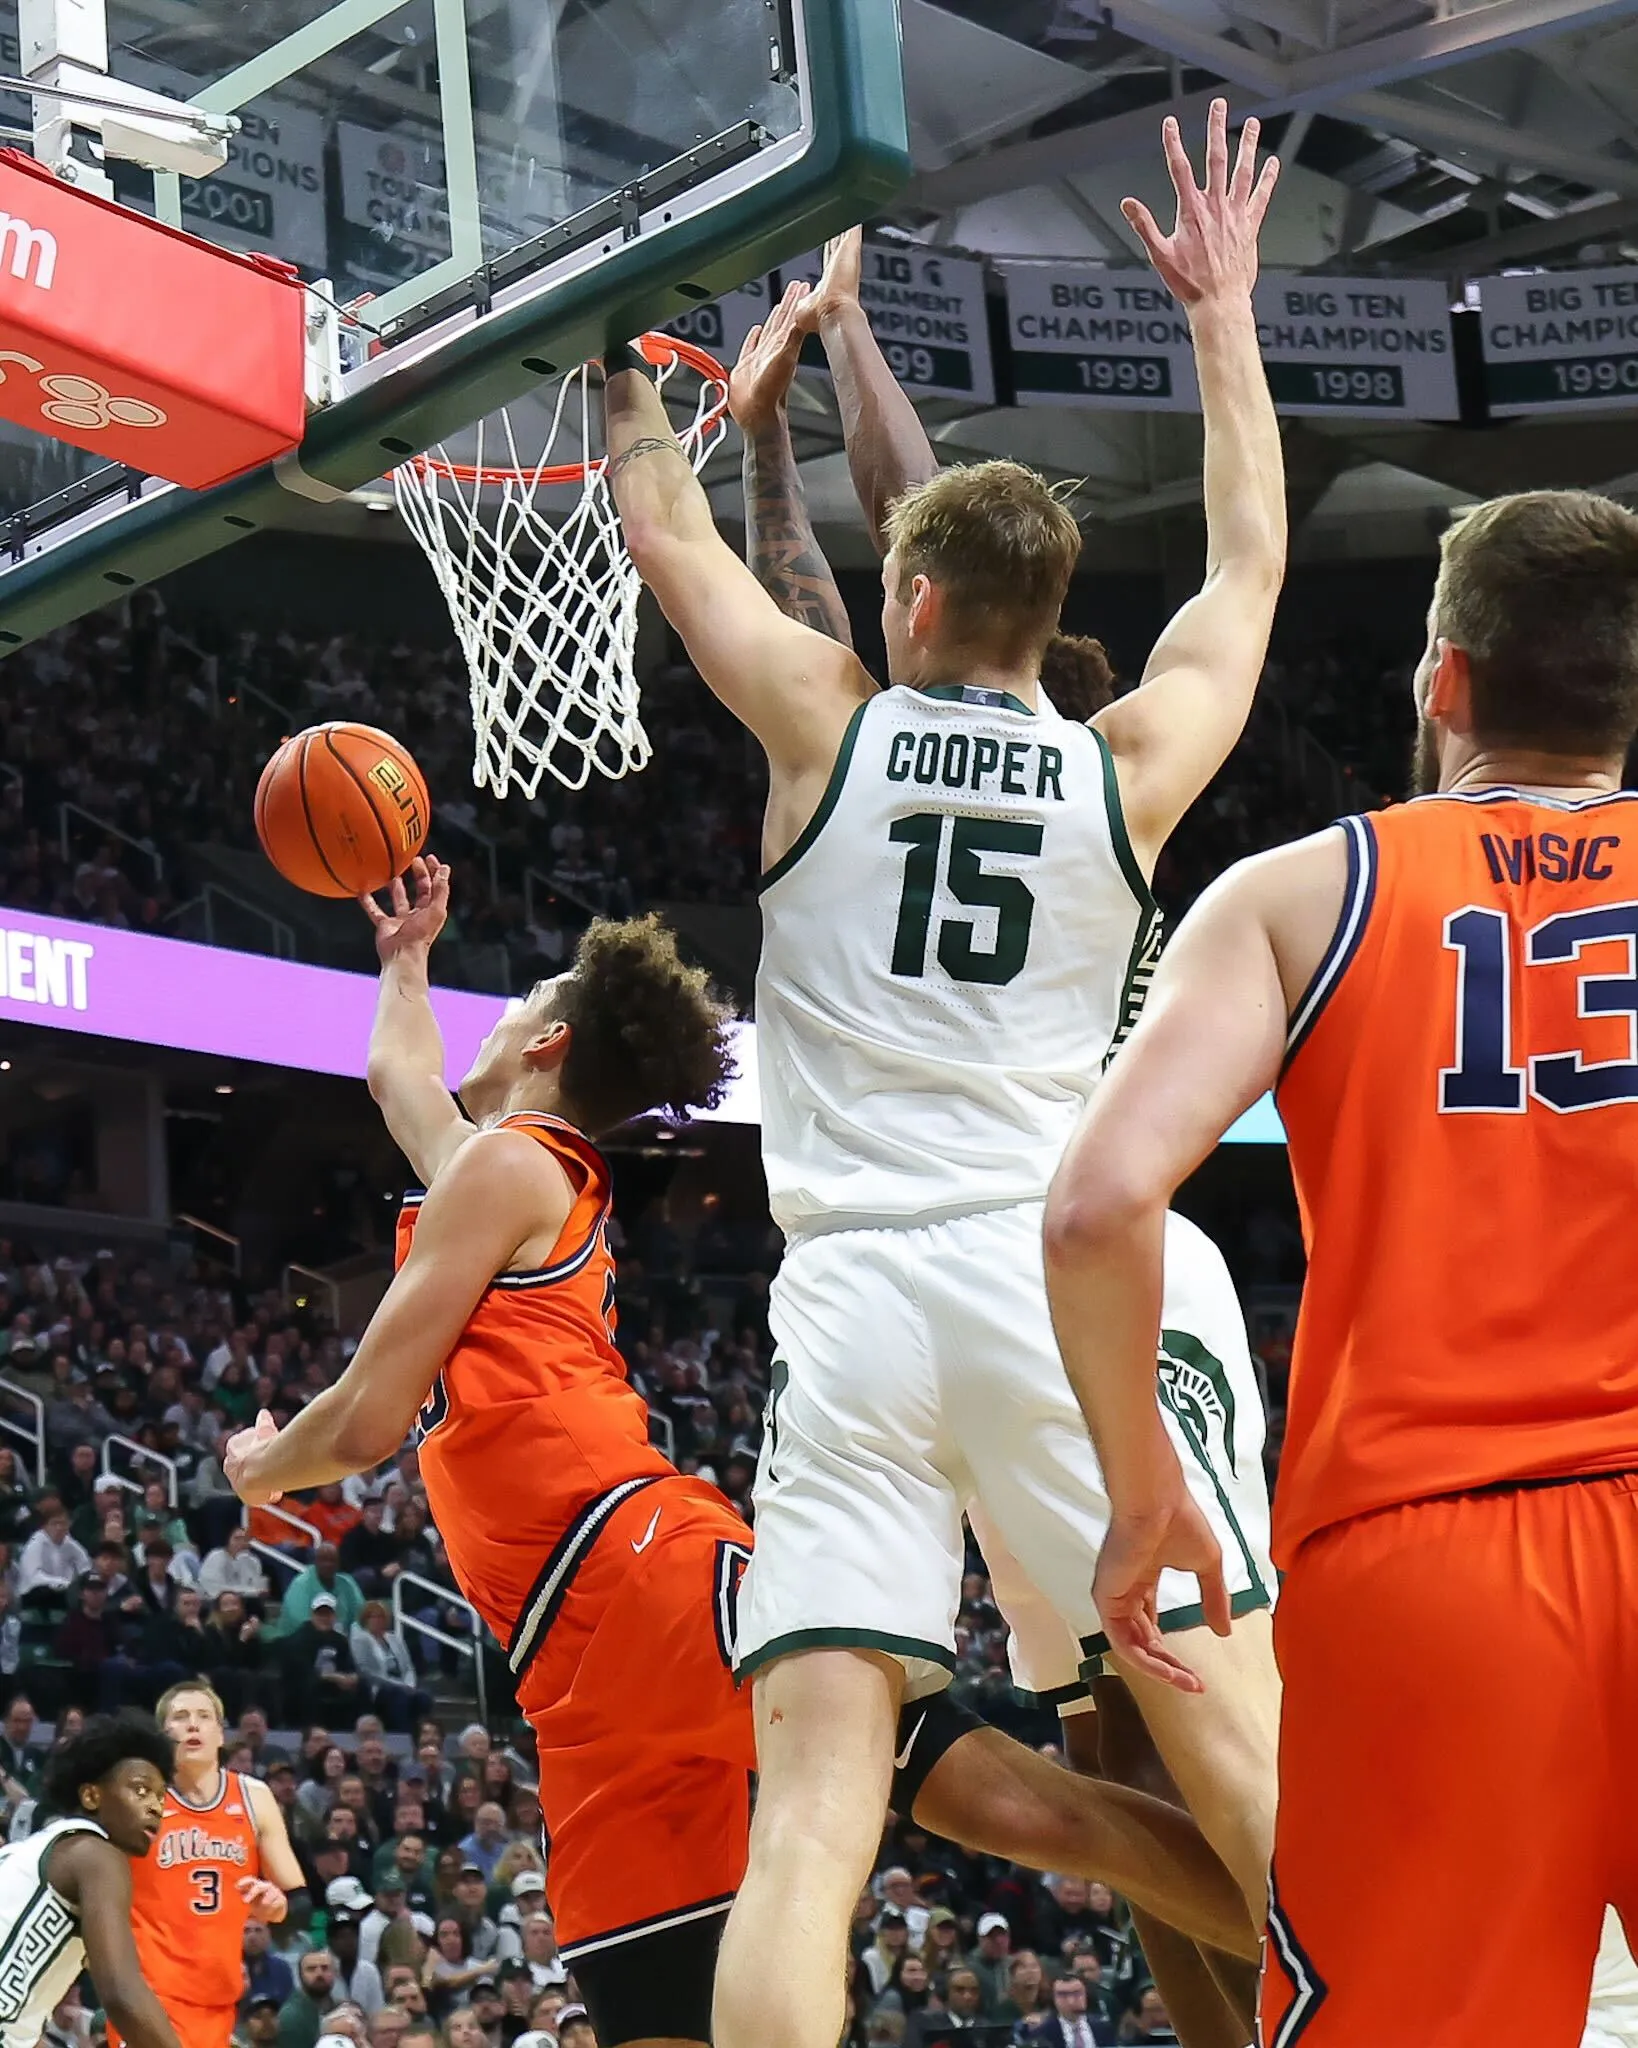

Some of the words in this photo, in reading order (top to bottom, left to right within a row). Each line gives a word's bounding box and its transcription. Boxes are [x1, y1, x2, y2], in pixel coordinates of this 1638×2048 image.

[240, 112, 281, 145] EN
[228, 143, 320, 193] PIONS
[182, 180, 267, 229] 2001
[1052, 284, 1104, 309] BIG
[1113, 287, 1174, 312] TEN
[1284, 291, 1339, 317] BIG
[1346, 293, 1406, 319] TEN
[1526, 286, 1583, 314] BIG
[672, 307, 718, 339] 00
[868, 309, 969, 344] MPIONS
[1016, 315, 1193, 345] CHAMPION
[1257, 324, 1448, 354] CHAMPIONS
[887, 346, 935, 383] 99
[1077, 360, 1162, 392] 1999
[1312, 371, 1396, 401] 1998
[885, 731, 1066, 801] COOPER
[373, 758, 422, 847] ELITE
[887, 812, 1045, 987] 15
[0, 928, 94, 1011] ENT
[1436, 899, 1638, 1115] 13
[158, 1828, 246, 1868] Illinois
[190, 1869, 221, 1914] 3
